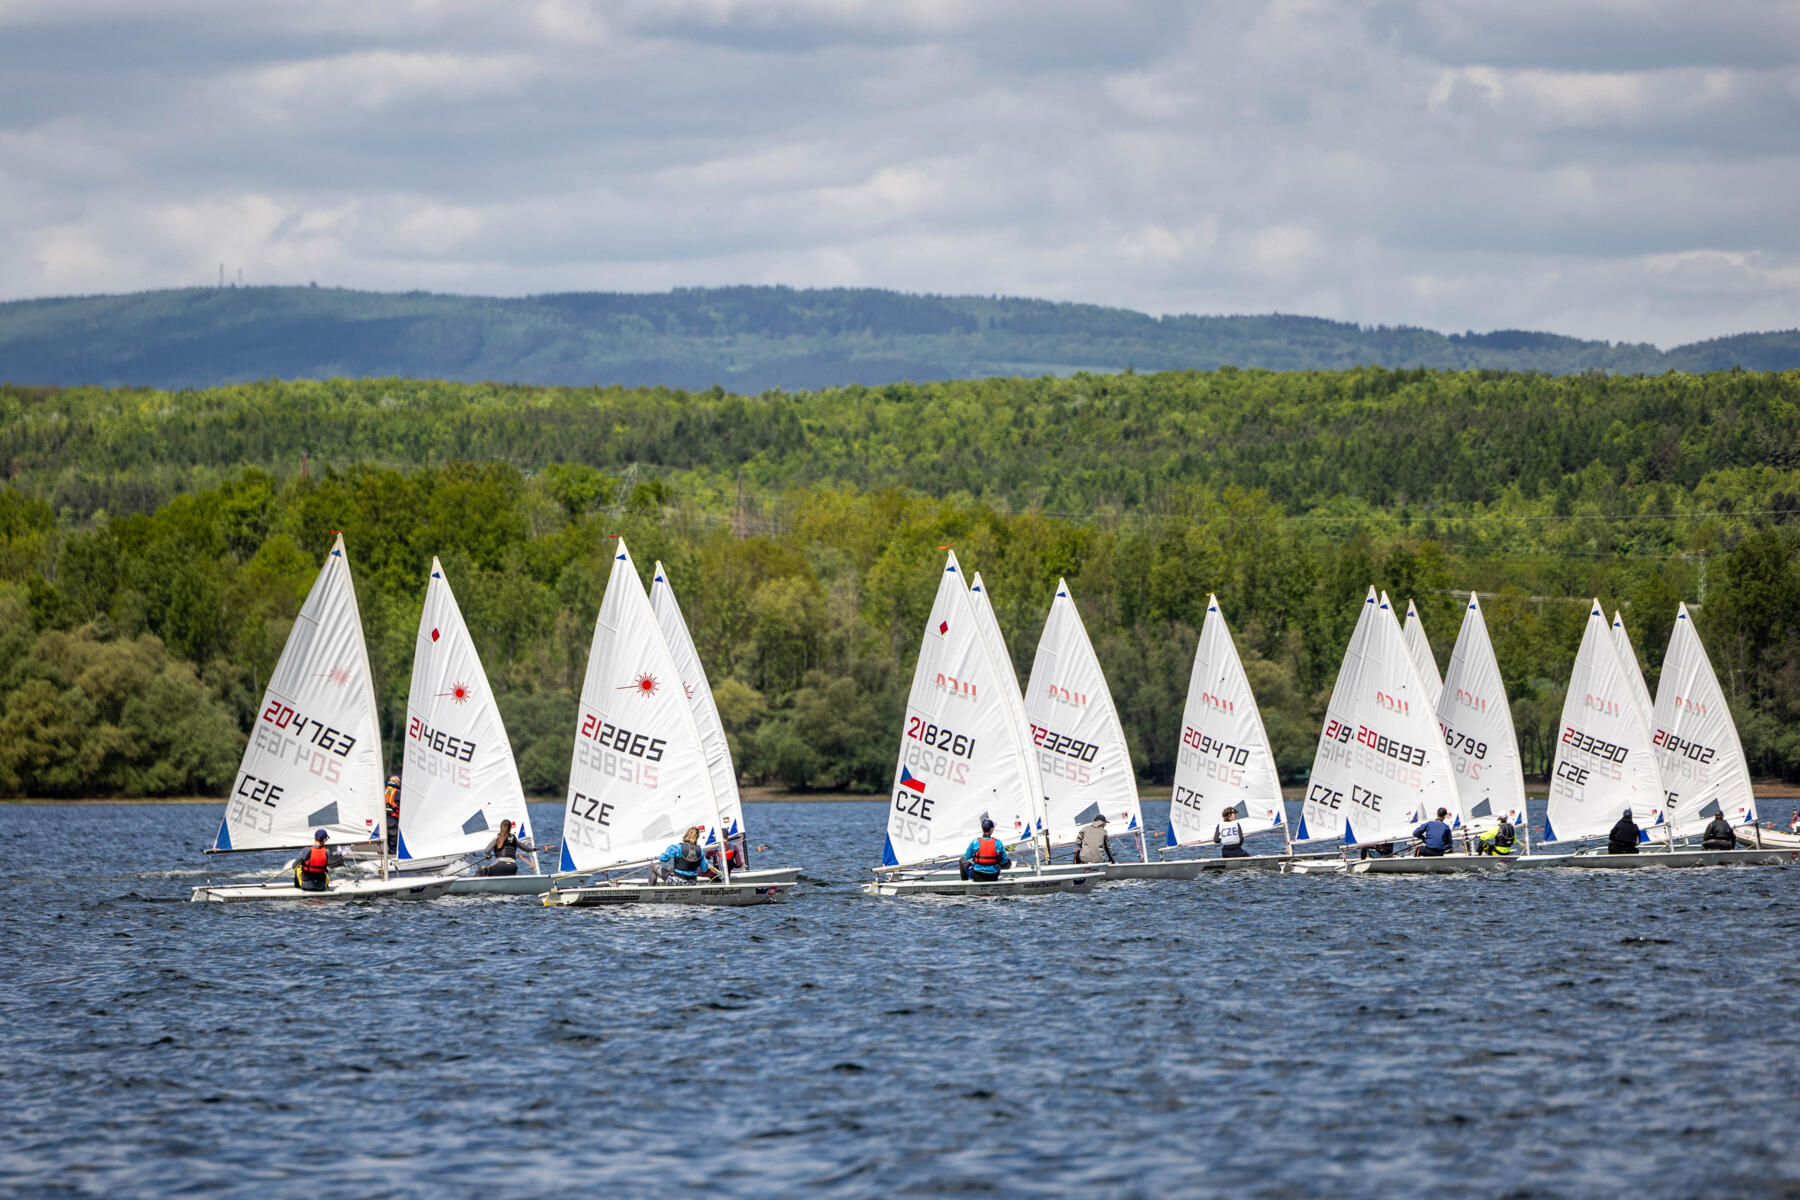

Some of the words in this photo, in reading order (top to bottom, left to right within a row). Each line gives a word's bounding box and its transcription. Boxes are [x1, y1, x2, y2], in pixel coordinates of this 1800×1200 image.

[263, 700, 357, 758] 204763
[409, 716, 477, 763] 214653
[581, 713, 667, 762] 212865
[907, 716, 975, 760] 218261
[1183, 726, 1250, 767] 209470
[1357, 725, 1426, 767] 208693
[1562, 727, 1629, 764] 233290
[1653, 729, 1716, 765] 218402
[237, 774, 285, 808] CZE
[1556, 761, 1590, 786] CZE
[571, 792, 615, 827] CZE
[895, 790, 935, 821] CZE
[1175, 786, 1204, 811] CZE
[1309, 784, 1344, 810] CZE
[1351, 784, 1382, 812] CZE
[1220, 827, 1238, 838] CZE
